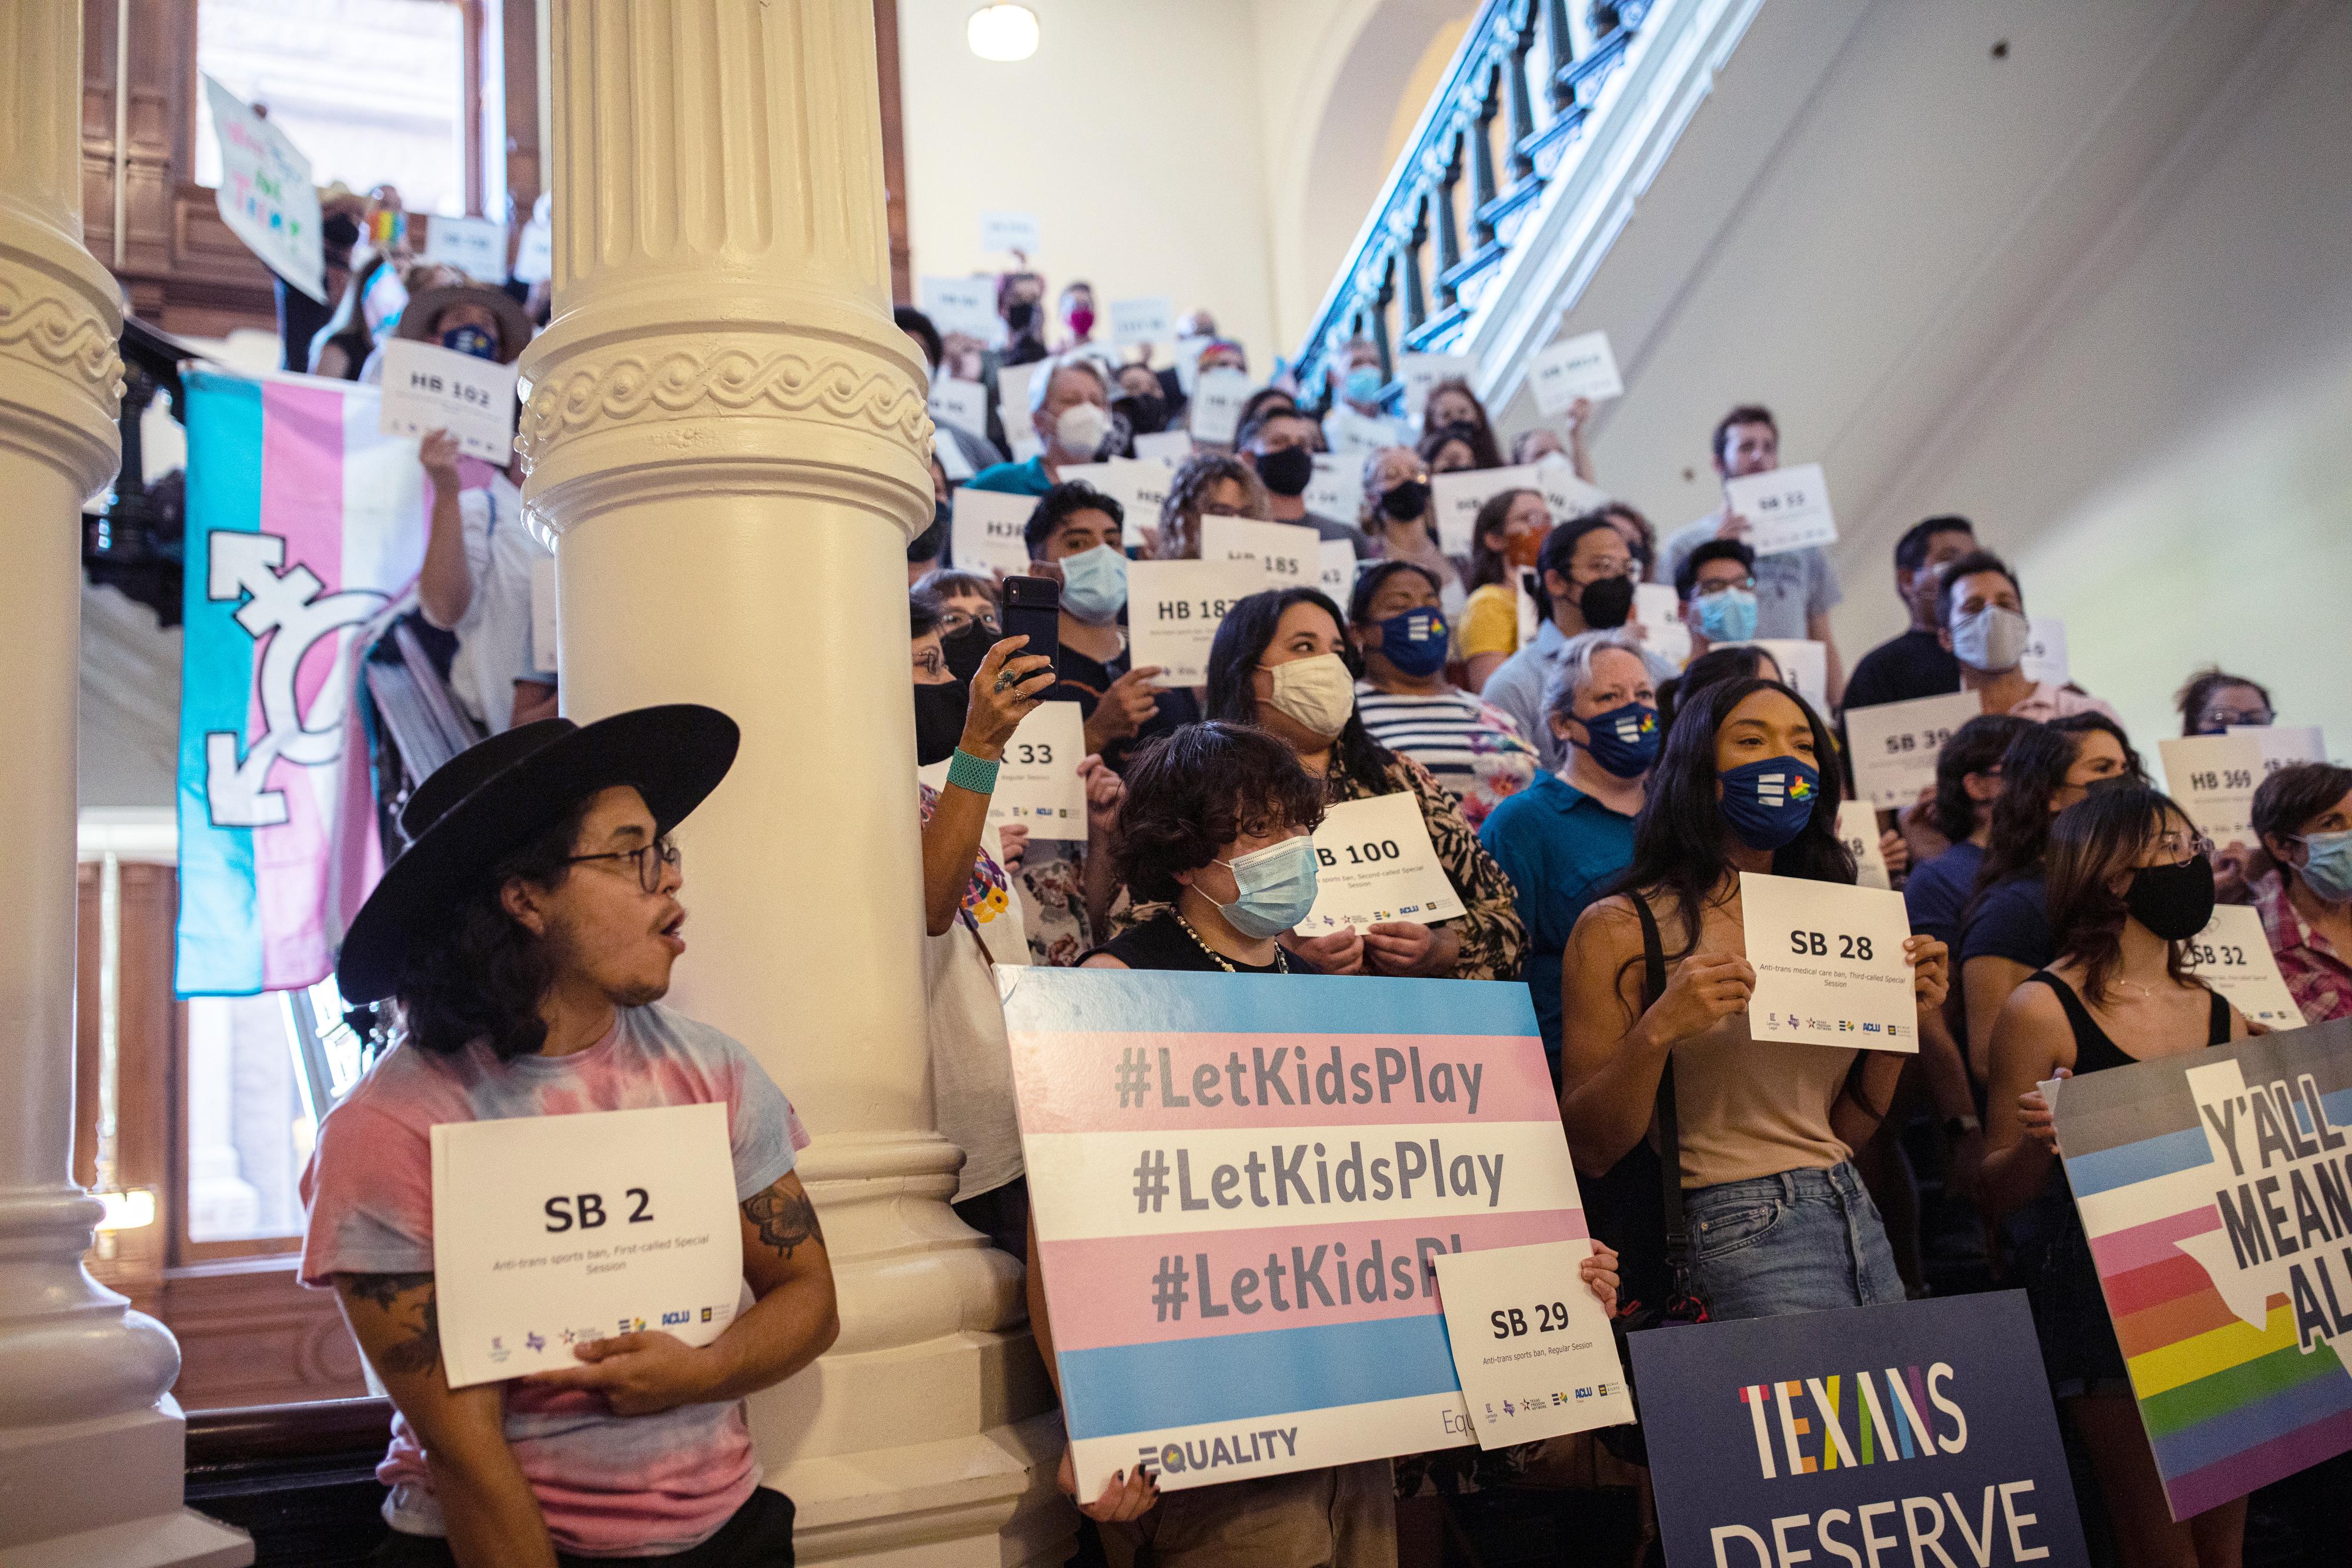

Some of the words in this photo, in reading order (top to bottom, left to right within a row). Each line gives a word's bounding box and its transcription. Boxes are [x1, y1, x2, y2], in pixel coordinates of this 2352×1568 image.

[410, 370, 445, 393] HB
[451, 381, 492, 408] 102
[1265, 555, 1299, 576] 185
[1158, 600, 1190, 619] HB
[1018, 744, 1053, 764] 33
[1885, 733, 1917, 755] SB
[2193, 771, 2219, 791] HB
[1345, 840, 1400, 865] 100
[1402, 865, 1424, 874] Special
[1399, 905, 1419, 915] ACLU
[1790, 930, 1828, 956] SB
[1838, 934, 1874, 961] 28
[2220, 944, 2247, 965] 32
[1759, 963, 1792, 973] Anti-trans
[1793, 967, 1817, 975] medical
[1834, 971, 1847, 979] ban,
[1849, 972, 1883, 982] Third-called
[1885, 975, 1906, 984] Special
[1824, 979, 1847, 988] Session
[1863, 1022, 1880, 1032] ACLU
[1114, 1045, 1484, 1115] #LetKidsPlay
[2201, 1079, 2346, 1176] Y'ALL
[1132, 1138, 1504, 1214] #LetKidsPlay
[543, 1193, 608, 1233] SB
[625, 1187, 655, 1224] 2
[2216, 1153, 2352, 1270] MEAN
[492, 1256, 547, 1272] Anti-trans
[551, 1252, 584, 1265] sports
[586, 1248, 610, 1260] ban,
[614, 1239, 672, 1256] First-called
[674, 1234, 710, 1249] Special
[585, 1261, 627, 1275] Session
[662, 1310, 690, 1326] ACLU
[1491, 1308, 1528, 1339] SB
[1534, 1301, 1569, 1333] 29
[1482, 1355, 1512, 1366] Anti-trans
[1514, 1350, 1532, 1361] sports
[1534, 1349, 1547, 1357] ban,
[1548, 1345, 1571, 1355] Regular
[1572, 1341, 1593, 1350] Session
[1575, 1386, 1593, 1399] ACLU
[1738, 1362, 1968, 1479] TEXANS
[1138, 1426, 1298, 1476] EQUALITY
